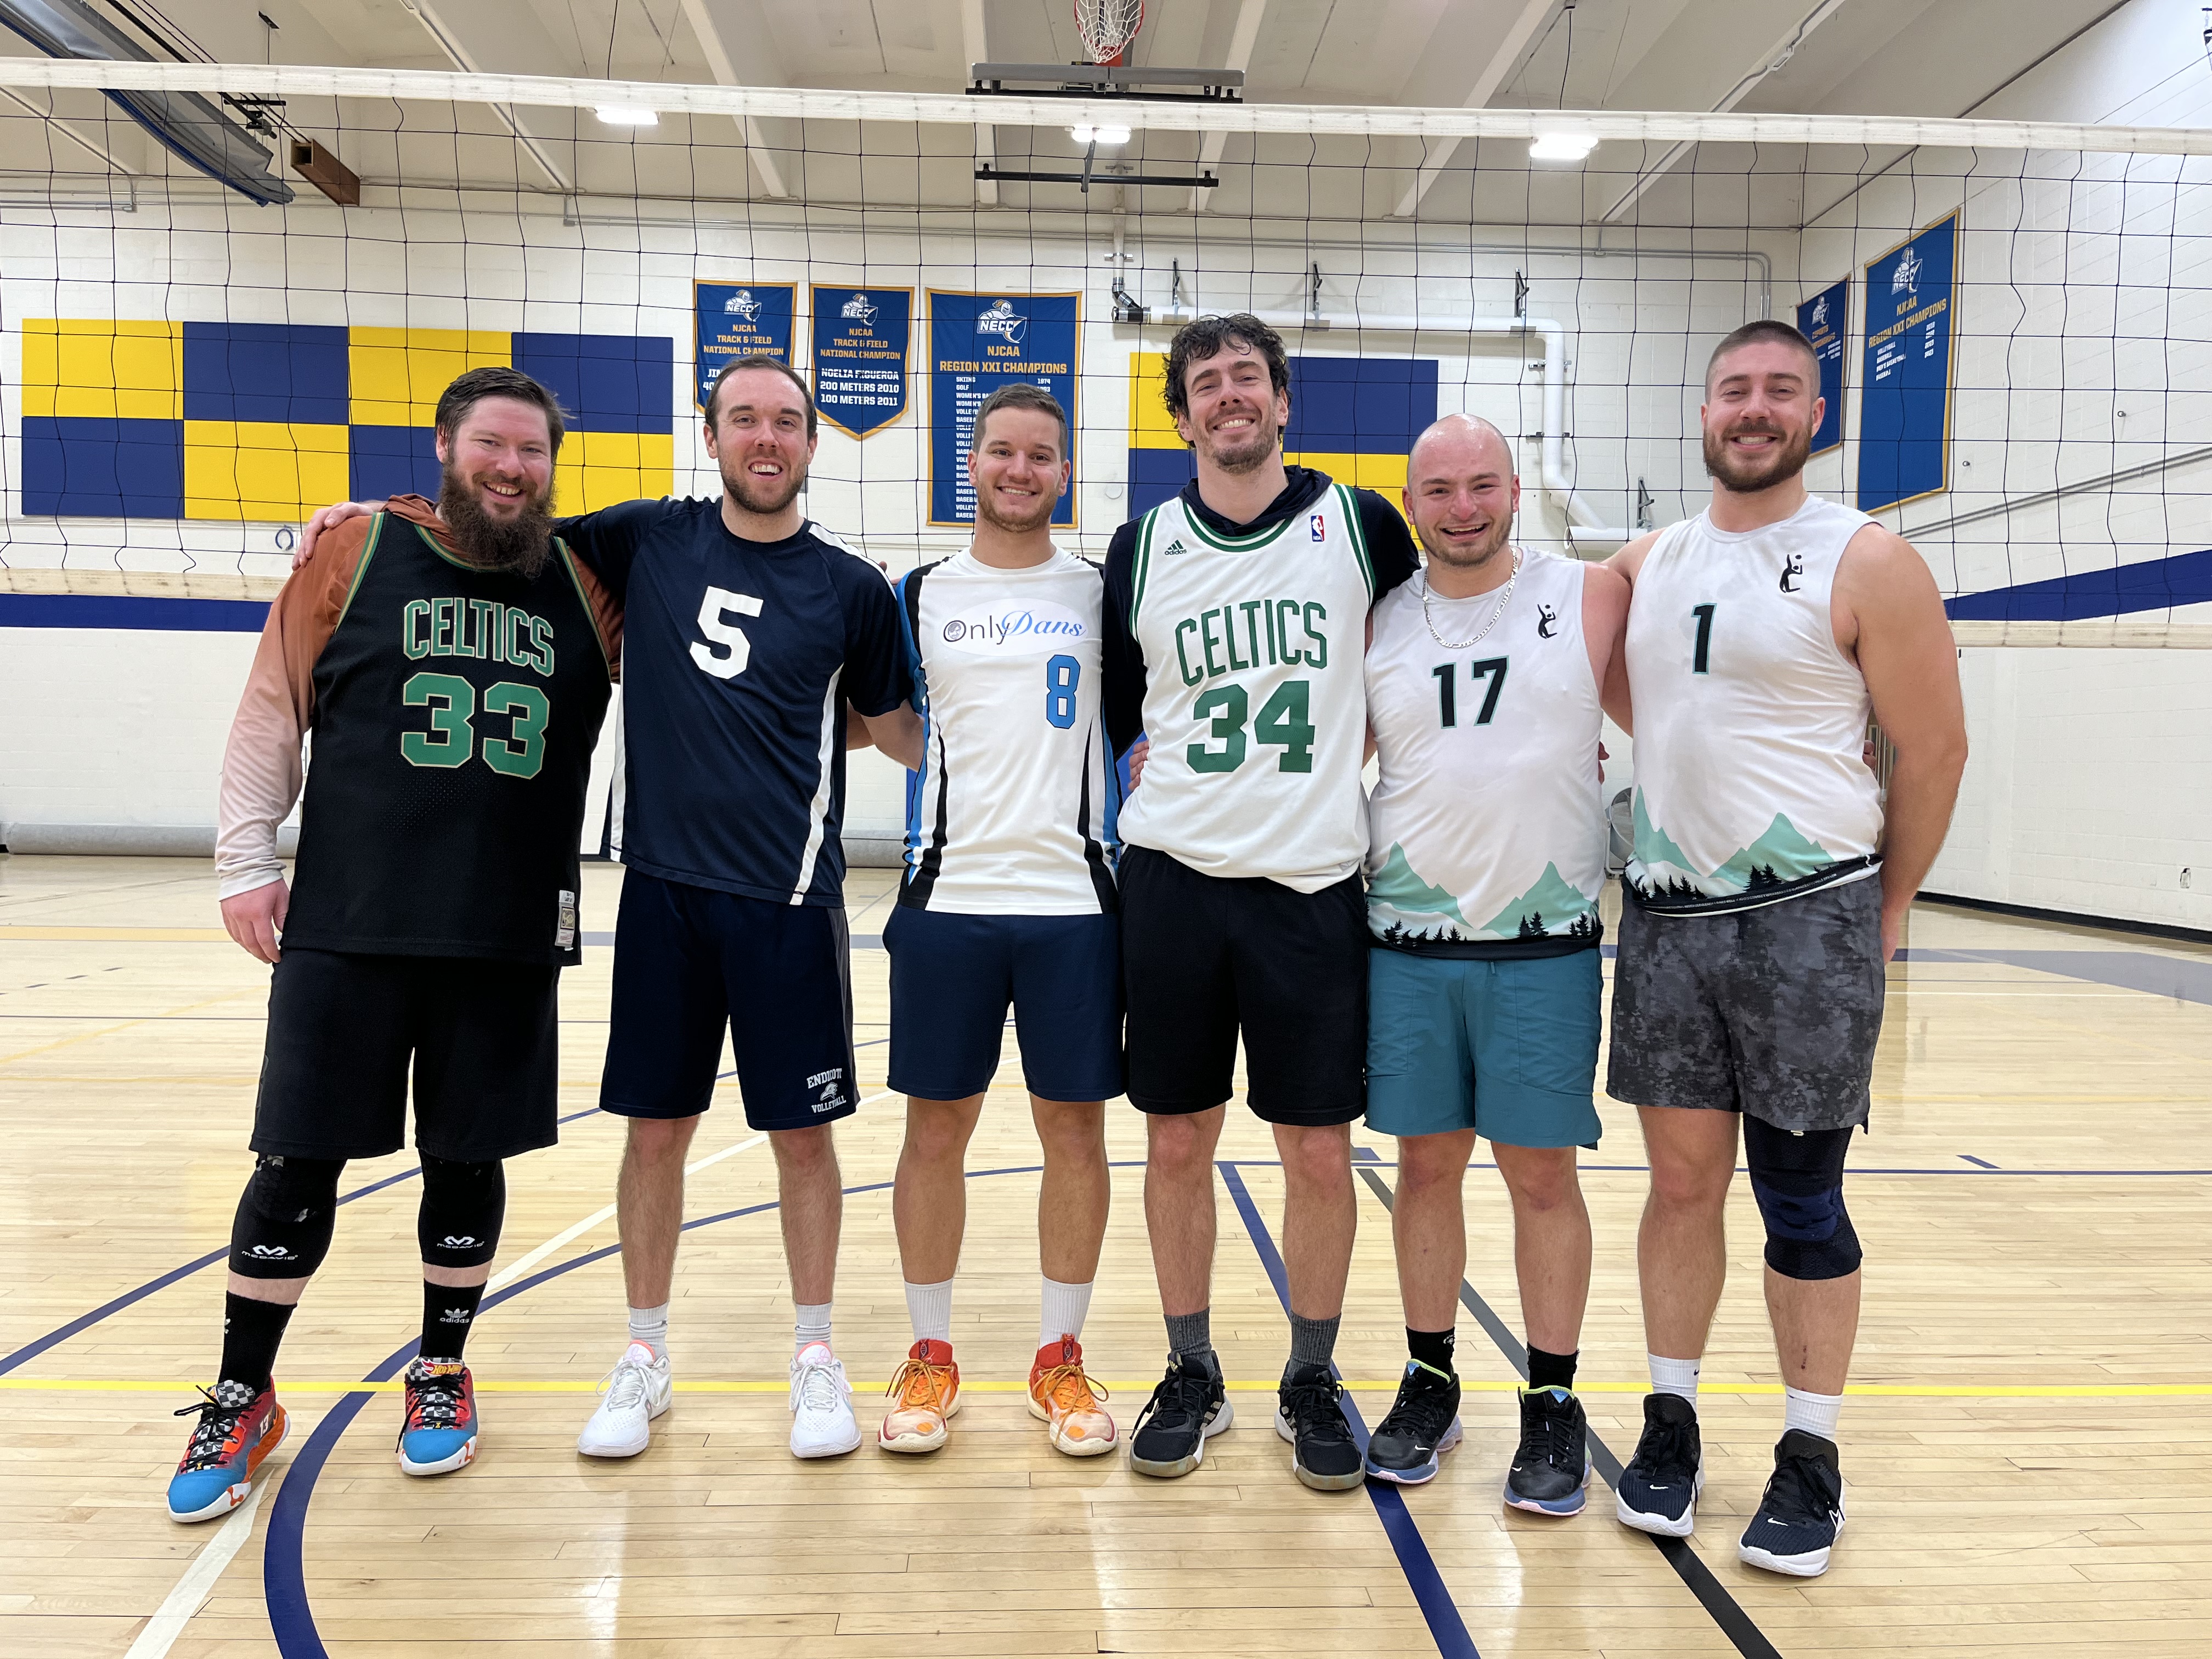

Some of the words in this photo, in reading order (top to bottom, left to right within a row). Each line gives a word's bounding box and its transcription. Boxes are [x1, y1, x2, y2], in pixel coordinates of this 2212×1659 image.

[1897, 295, 1917, 316] NJCAA
[843, 308, 869, 317] NECC
[732, 324, 757, 332] NJCAA
[980, 320, 1014, 332] NECC
[1869, 326, 1892, 348] REGION
[1893, 319, 1905, 335] XXI
[1906, 298, 1946, 329] CHAMPIONS
[849, 328, 873, 337] NJCAA
[717, 335, 741, 343] TRACK
[751, 336, 772, 345] FIELD
[833, 338, 857, 347] TRACK
[866, 340, 888, 348] FIELD
[703, 345, 741, 354] NATIONAL
[743, 347, 784, 356] CHAMPION
[820, 349, 857, 358] NATIONAL
[859, 351, 901, 360] CHAMPION
[988, 346, 1020, 357] NJCAA
[940, 361, 979, 373] REGION
[981, 362, 1001, 373] XXI
[1003, 362, 1067, 374] CHAMPIONS
[821, 368, 853, 378] NOELIA
[855, 369, 899, 380] FIGUEROA
[820, 381, 838, 391] 200
[839, 382, 876, 392] METERS
[877, 383, 899, 393] 2010
[821, 394, 838, 404] 100
[839, 395, 876, 405] METERS
[877, 397, 898, 406] 2011
[403, 597, 554, 677] CELTICS
[690, 586, 764, 679] 5
[1690, 602, 1718, 675] 1
[1175, 599, 1327, 687] CELTICS
[1047, 654, 1081, 729] 8
[1431, 655, 1509, 729] 17
[401, 672, 550, 780] 33
[1186, 680, 1315, 774] 34
